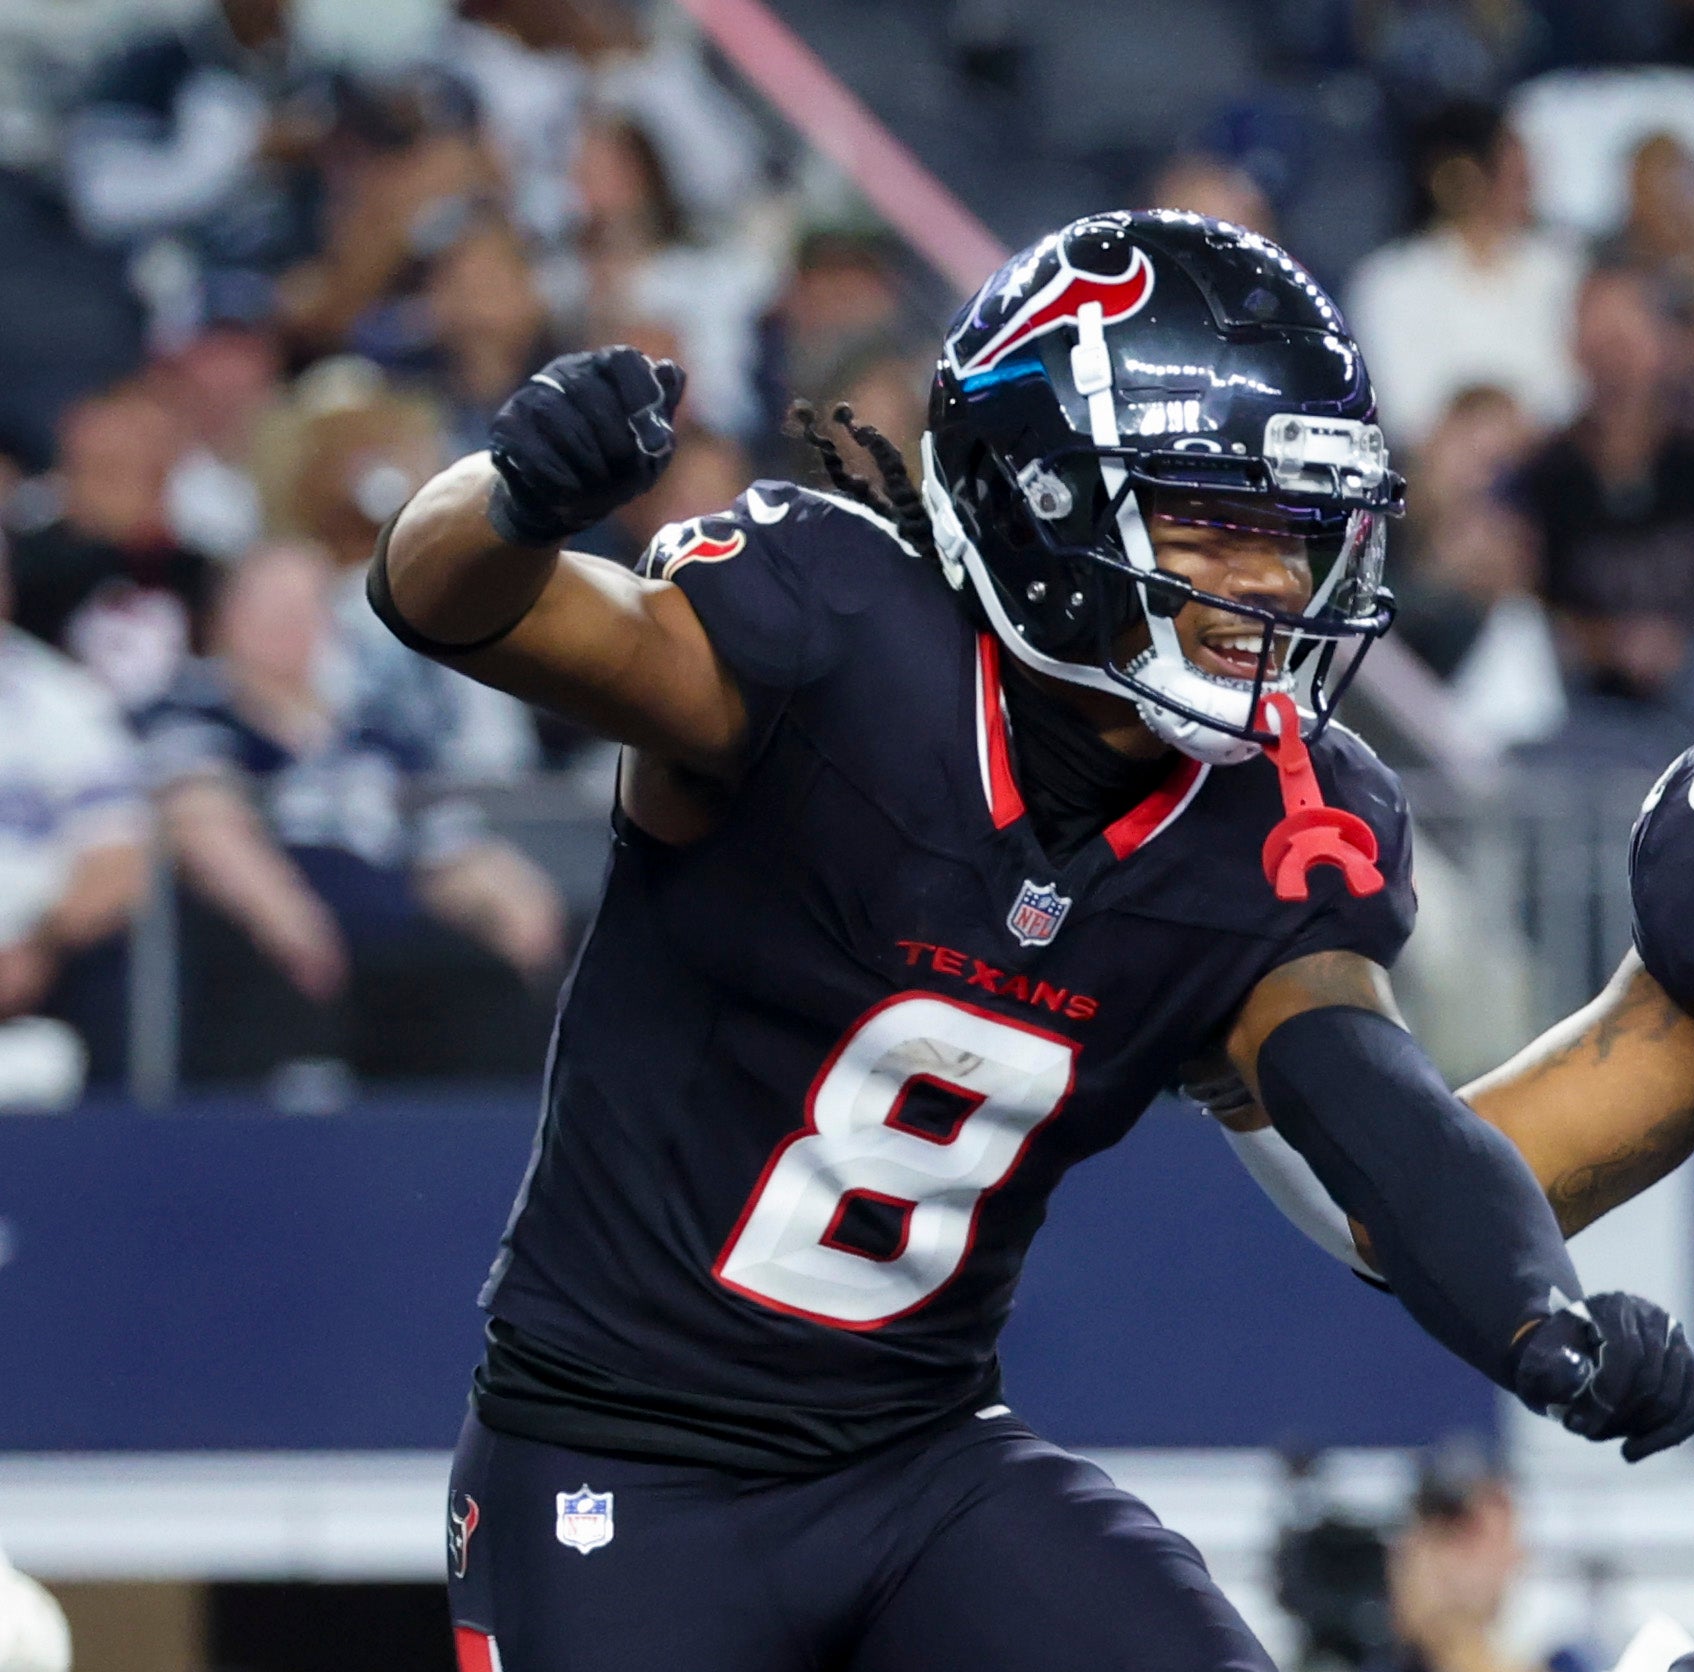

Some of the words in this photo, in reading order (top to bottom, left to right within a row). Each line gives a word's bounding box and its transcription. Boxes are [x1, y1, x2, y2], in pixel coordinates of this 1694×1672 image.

[1013, 905, 1056, 938] NFL
[895, 939, 1099, 1021] TEXANS
[711, 989, 1084, 1332] 8
